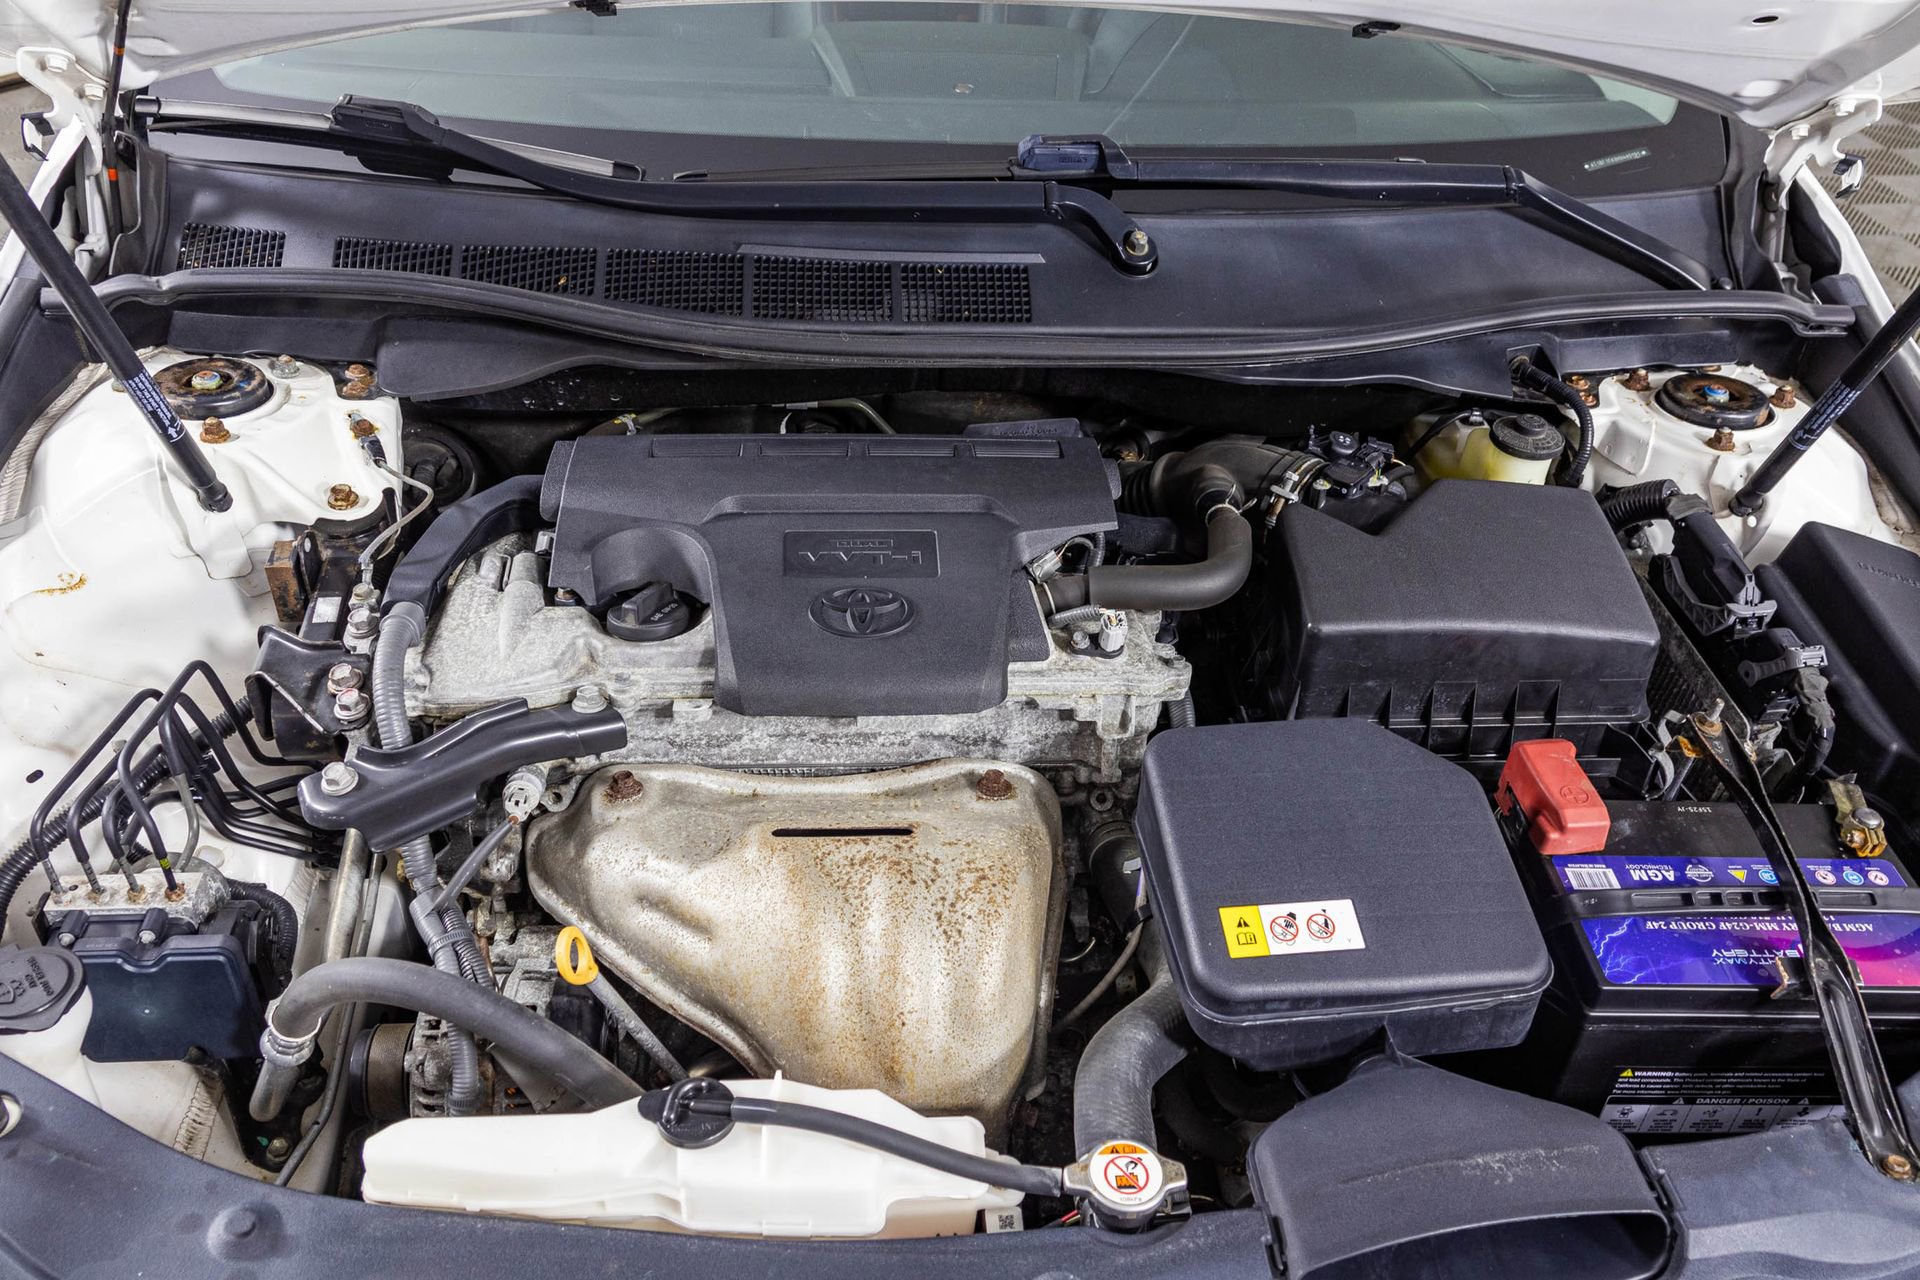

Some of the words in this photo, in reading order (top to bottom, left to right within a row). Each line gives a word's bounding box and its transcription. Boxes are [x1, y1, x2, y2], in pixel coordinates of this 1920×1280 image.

[836, 539, 889, 548] DUAL
[1630, 869, 1675, 881] AGM
[1646, 921, 1667, 930] 24F
[1670, 921, 1716, 930] GROUP
[1719, 921, 1780, 931] MM-G24F
[1843, 923, 1873, 932] AGM
[1712, 949, 1801, 958] BATTERY
